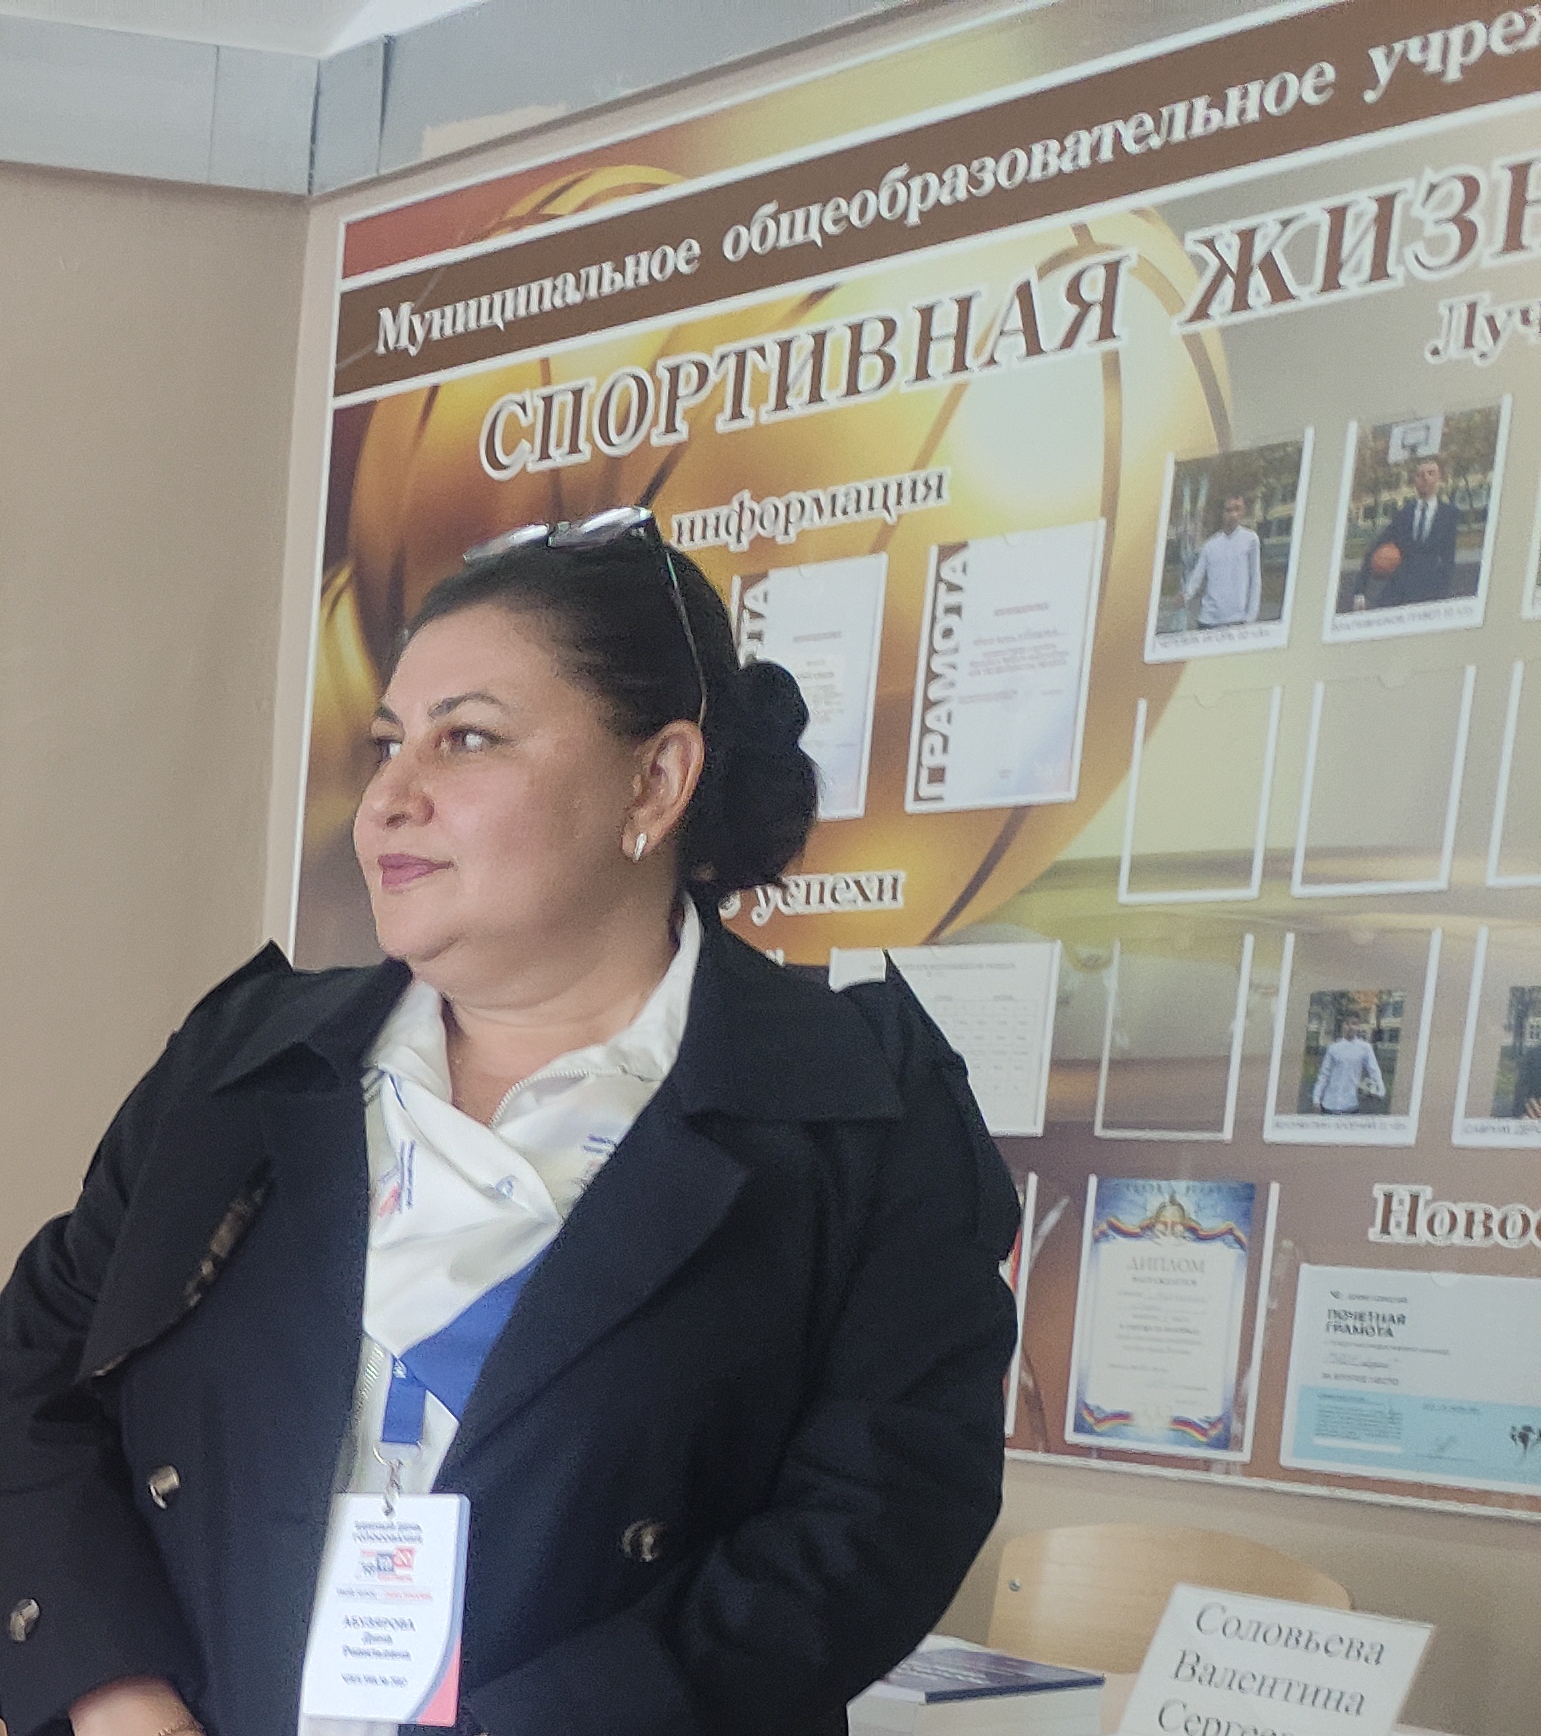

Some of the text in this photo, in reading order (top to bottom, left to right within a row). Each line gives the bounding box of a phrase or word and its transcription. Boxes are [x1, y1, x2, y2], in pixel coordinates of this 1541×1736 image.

[375, 238, 702, 357] Муниципальное
[721, 61, 1337, 263] общеобразовательное
[481, 251, 1135, 477] СПОРТИВНАЯ
[673, 469, 950, 550] информация
[919, 548, 968, 801] ГРАМОТА
[1372, 1185, 1541, 1246] Ново
[1195, 1601, 1386, 1667] Соловьева
[1172, 1649, 1366, 1717] Валентина
